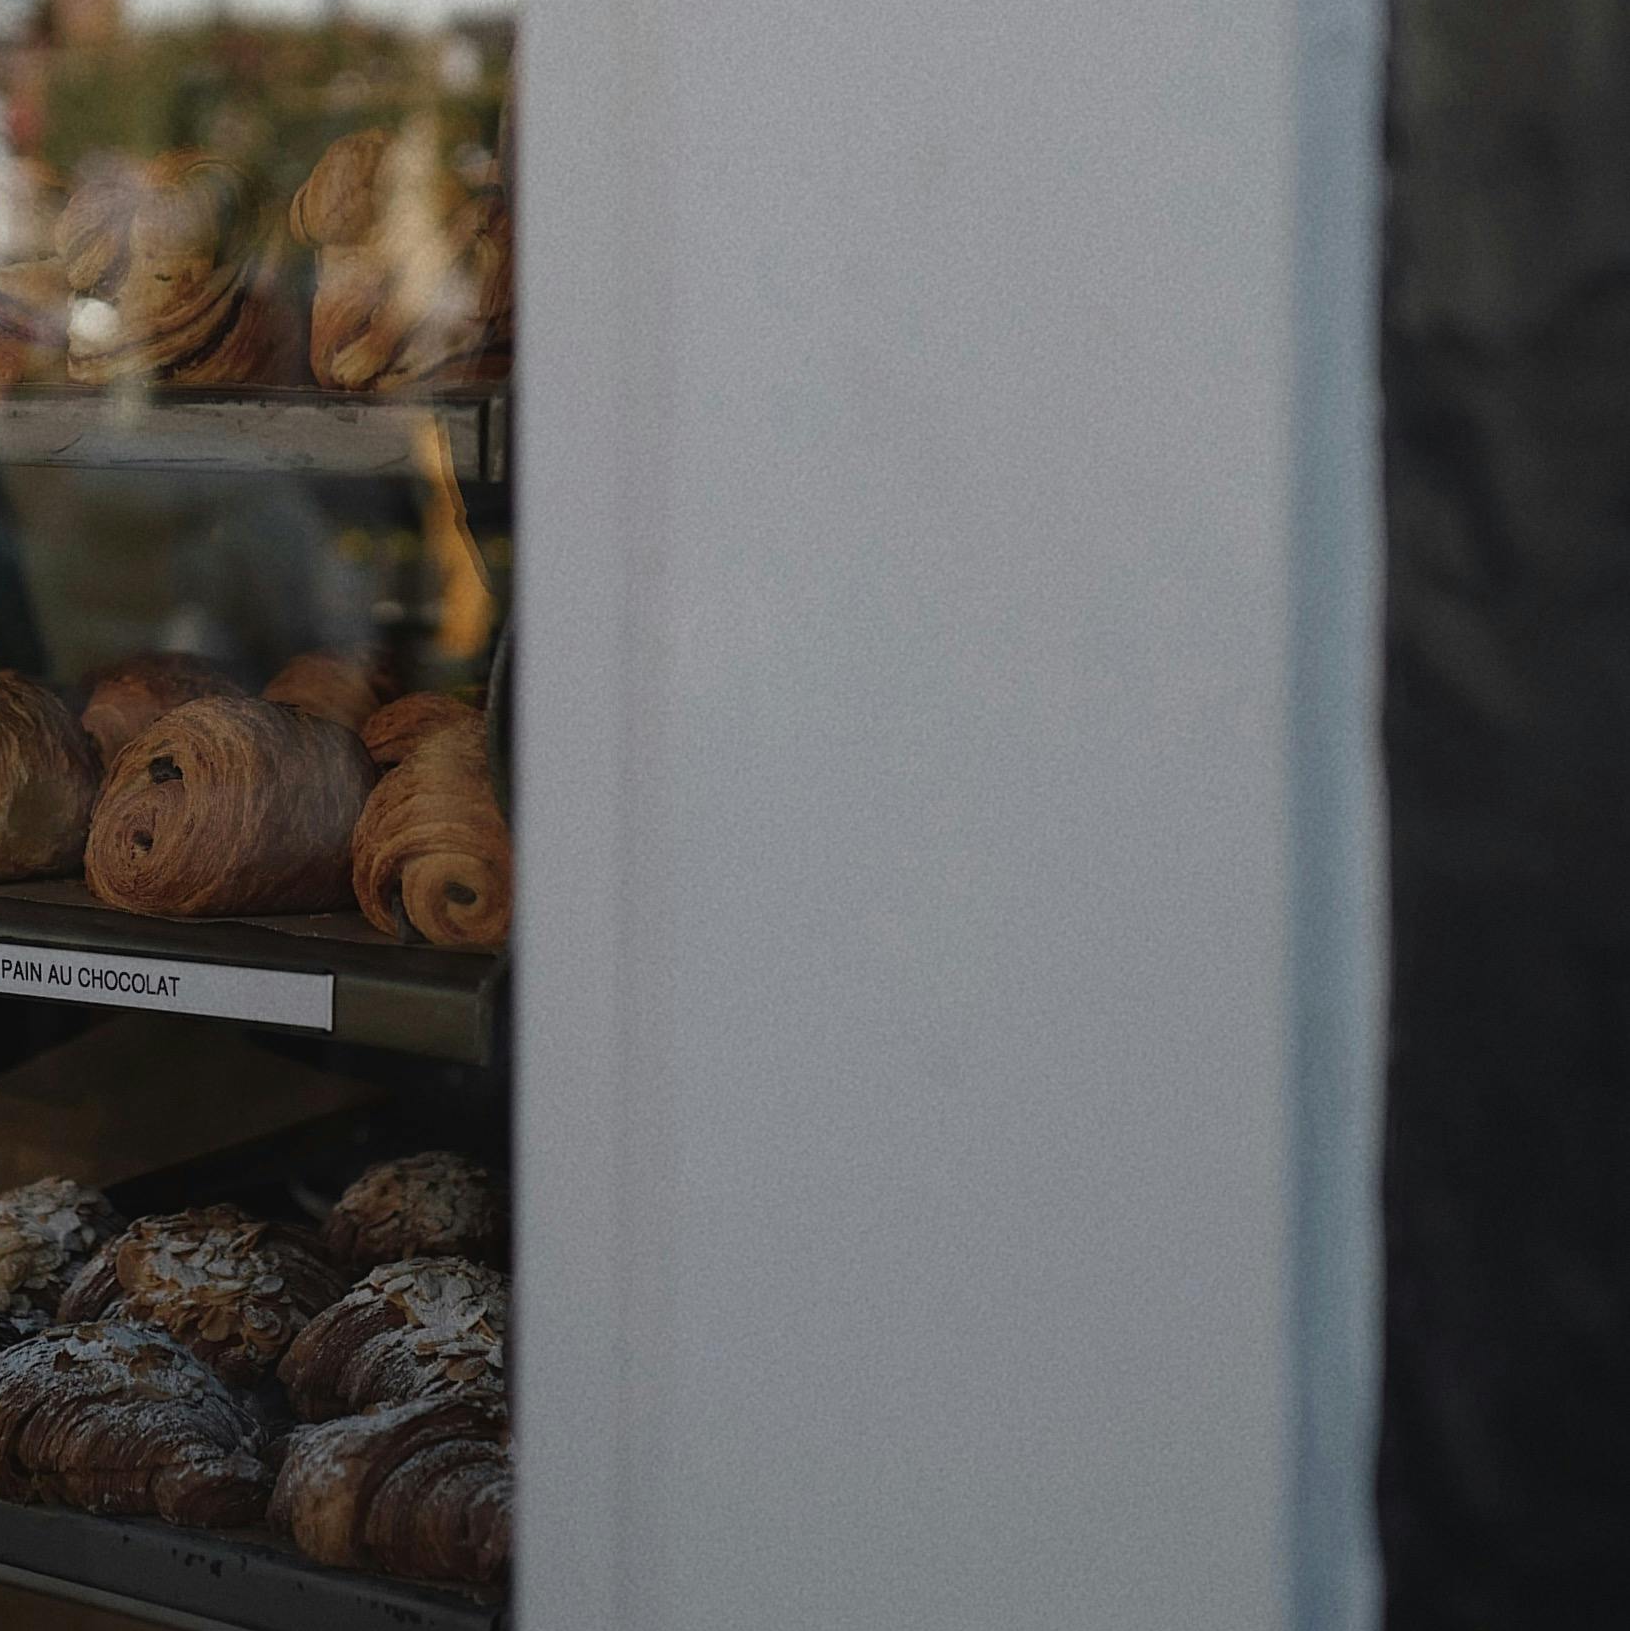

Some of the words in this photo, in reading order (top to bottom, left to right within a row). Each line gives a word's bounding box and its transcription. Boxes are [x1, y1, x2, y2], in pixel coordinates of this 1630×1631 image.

[1, 958, 42, 983] PAIN
[46, 963, 72, 986] AU
[77, 966, 181, 998] CHOCOLAT
